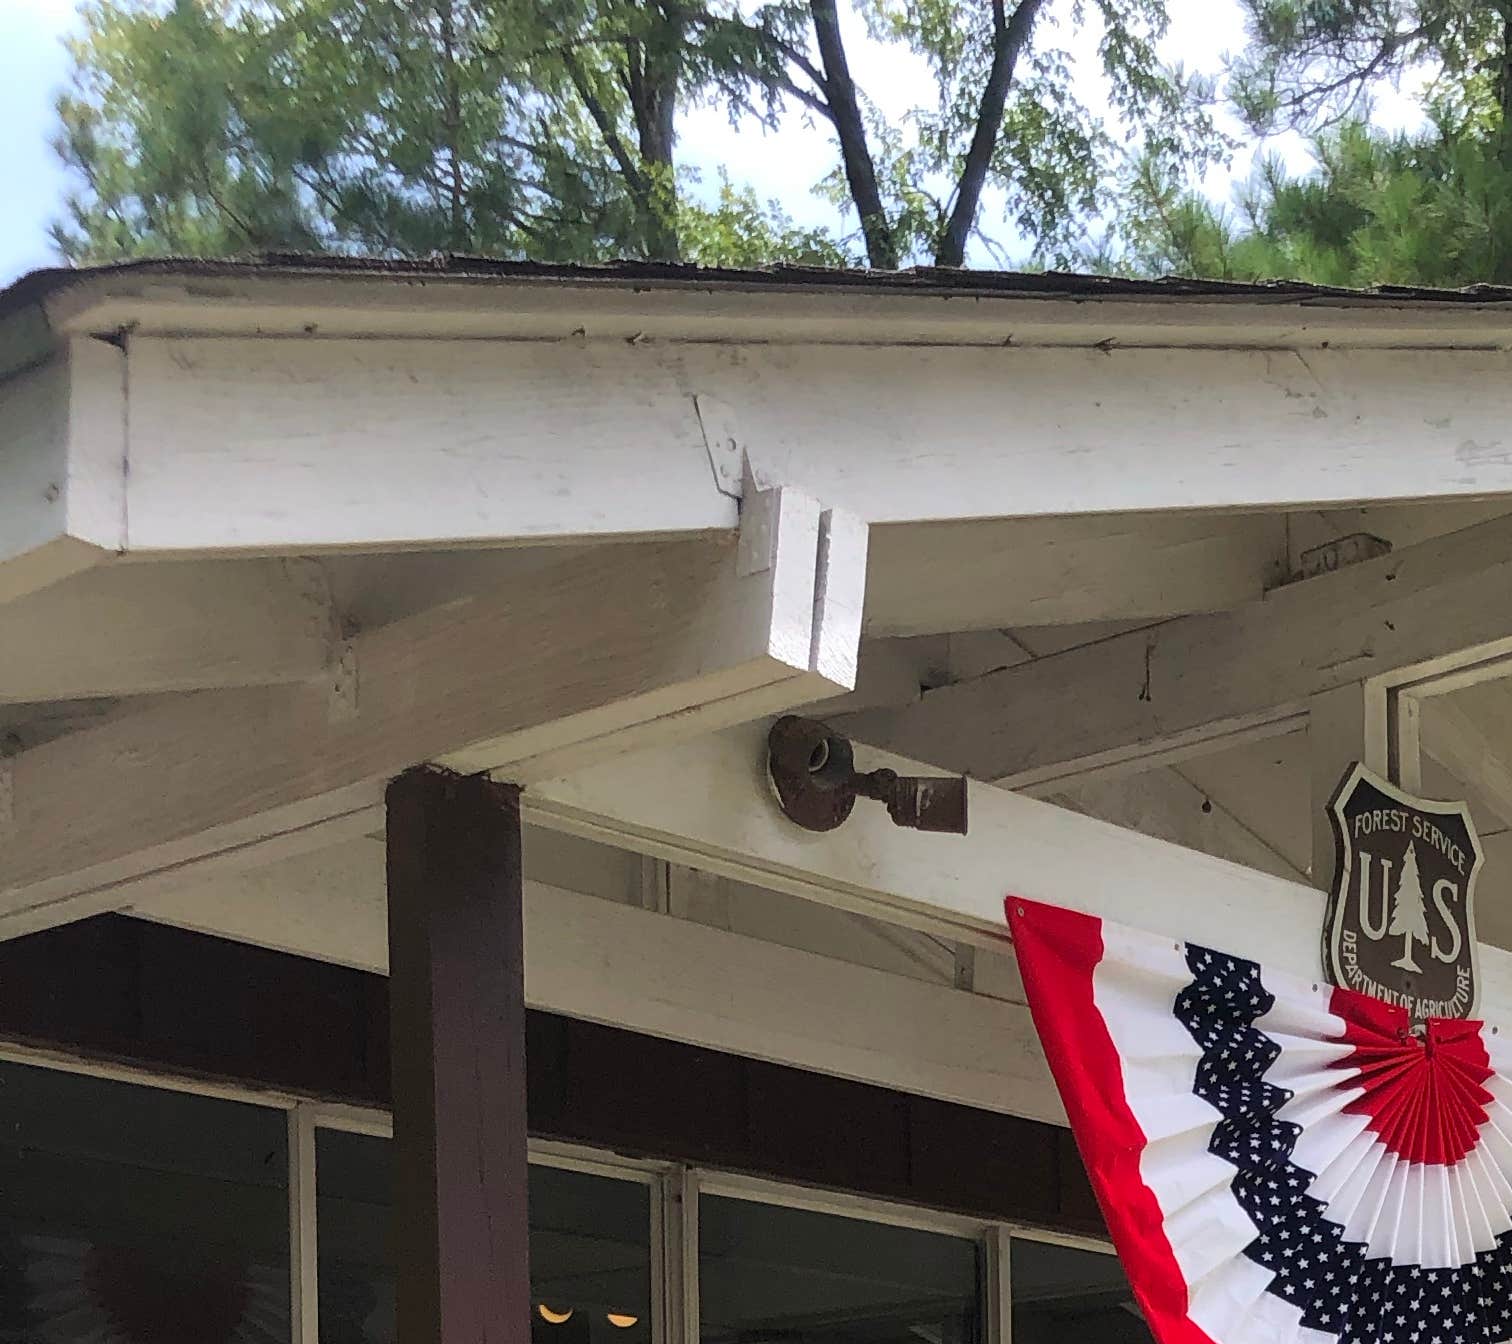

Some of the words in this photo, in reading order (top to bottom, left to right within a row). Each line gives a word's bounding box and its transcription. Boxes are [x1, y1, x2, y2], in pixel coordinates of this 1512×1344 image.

[1355, 809, 1409, 838] FOREST
[1413, 816, 1466, 875] SERVICE
[1359, 851, 1392, 941] U
[1431, 879, 1462, 964] S
[1343, 930, 1400, 1006] DEPARTMENT
[1400, 995, 1414, 1017] OF
[1414, 964, 1470, 1020] AGRICULTURE
